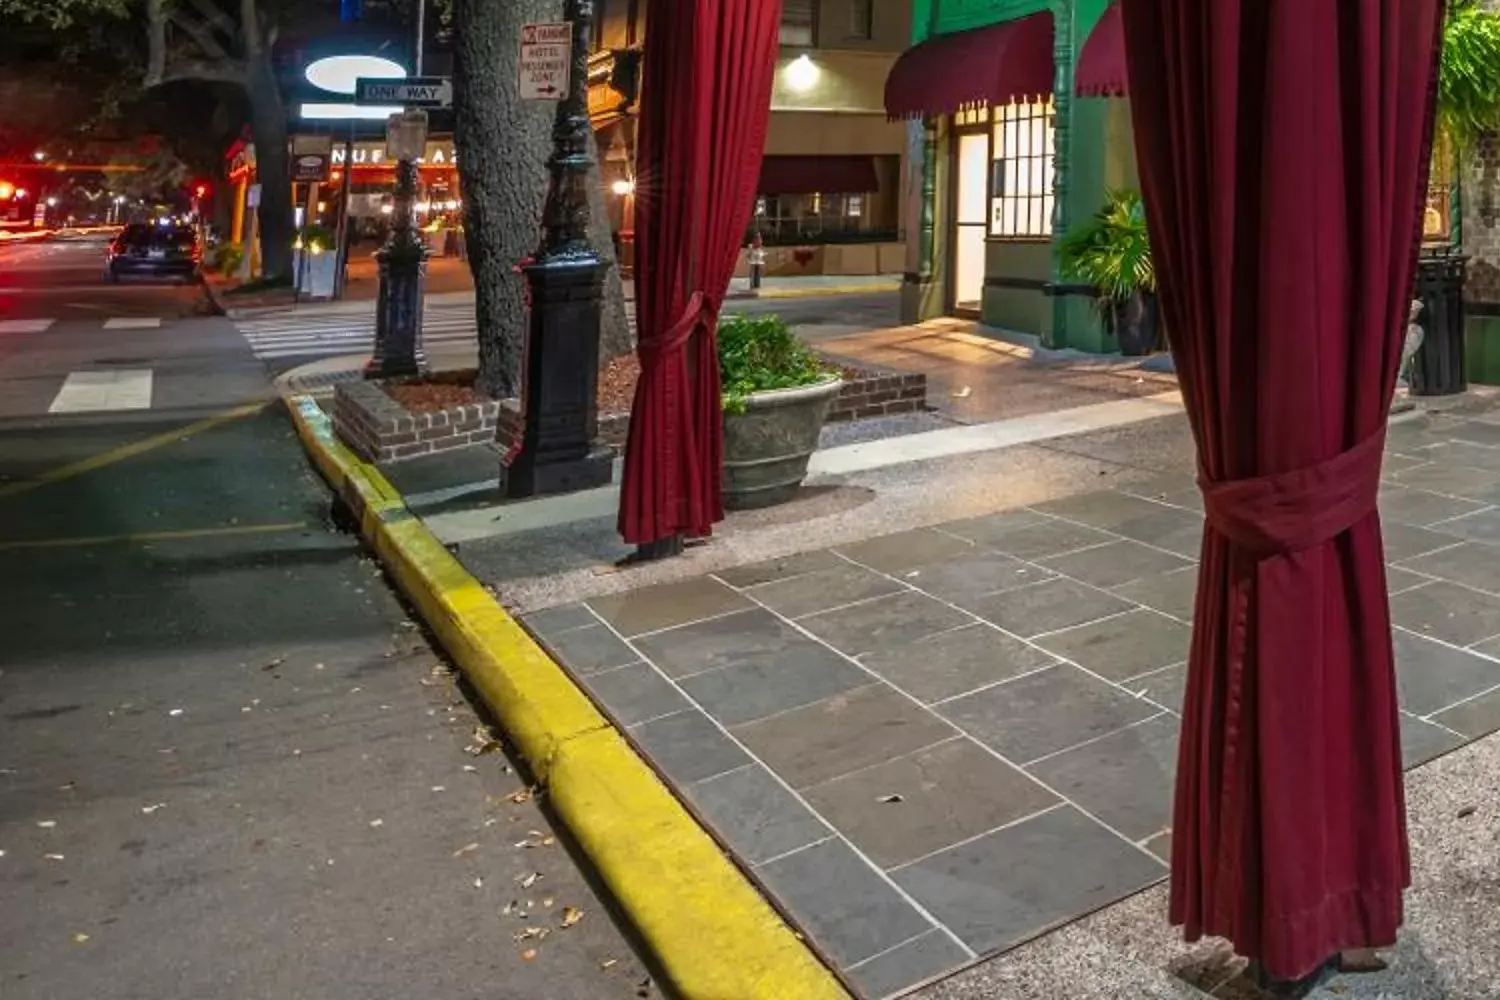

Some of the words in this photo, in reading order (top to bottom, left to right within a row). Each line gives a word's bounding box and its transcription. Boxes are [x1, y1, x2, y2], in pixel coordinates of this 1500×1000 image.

[368, 86, 397, 98] ONE
[406, 86, 438, 98] WAY
[331, 149, 384, 163] NUE
